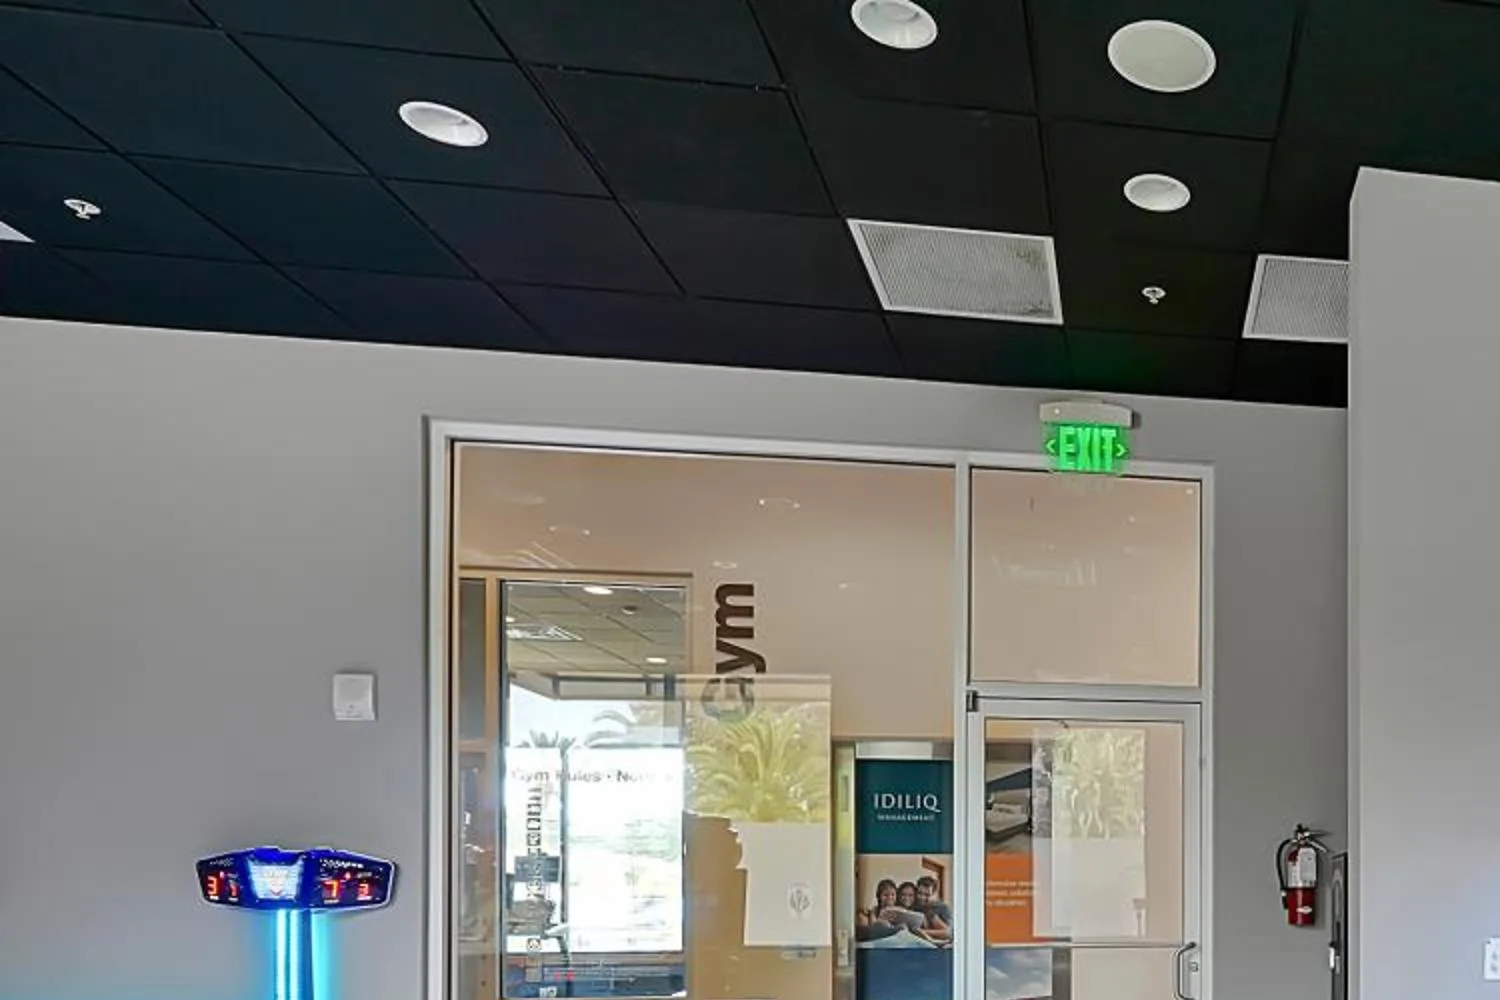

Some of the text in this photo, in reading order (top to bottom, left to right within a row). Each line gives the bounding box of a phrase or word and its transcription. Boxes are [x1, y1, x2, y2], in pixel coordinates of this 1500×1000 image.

[1059, 426, 1117, 471] EXIT
[701, 583, 766, 721] Gym
[873, 793, 942, 813] IDILIQ
